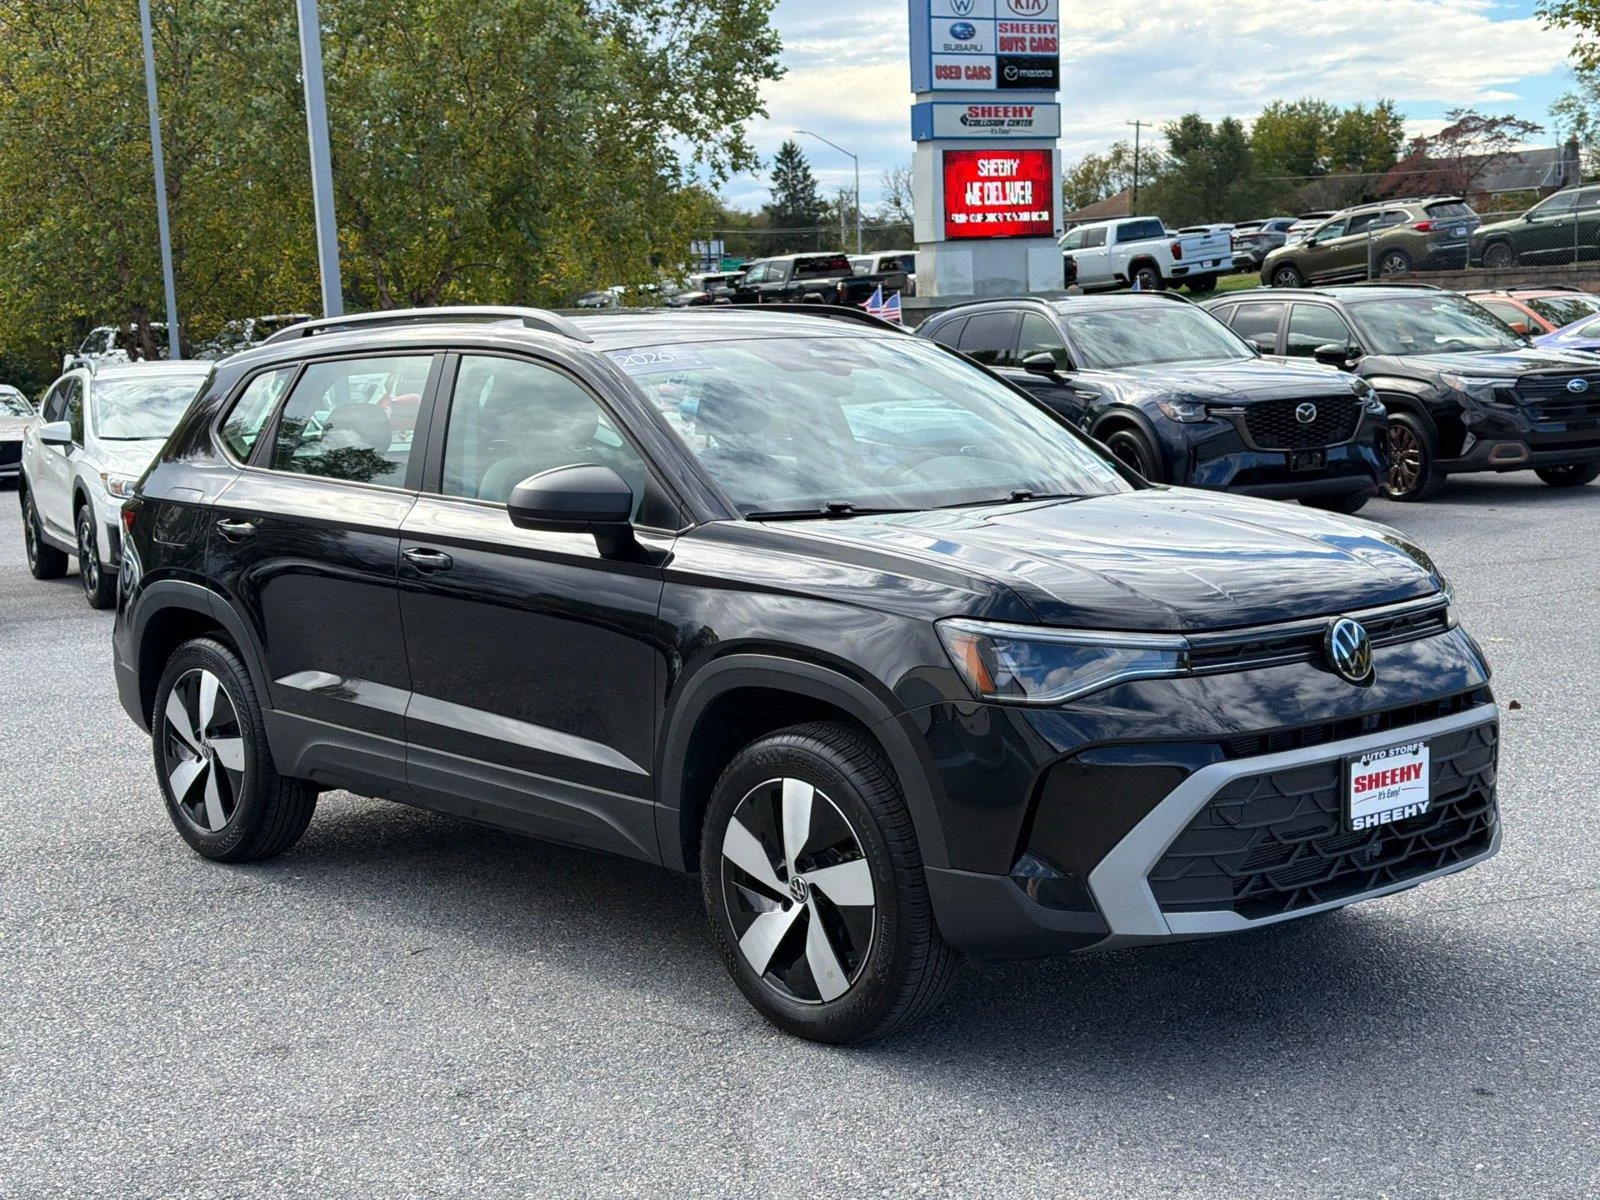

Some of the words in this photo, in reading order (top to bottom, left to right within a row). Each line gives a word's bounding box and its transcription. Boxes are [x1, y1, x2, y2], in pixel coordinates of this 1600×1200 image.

[998, 22, 1056, 35] SHEEHY
[943, 43, 982, 52] SUBARU
[1000, 36, 1027, 52] BUYS
[1030, 36, 1057, 52] CARS
[935, 65, 962, 80] USED
[964, 65, 992, 80] CARS
[968, 106, 1034, 118] SHEEHY
[968, 119, 1005, 127] COLLISION
[1007, 119, 1034, 127] CENTER
[977, 158, 1020, 177] SHEEHY
[965, 181, 983, 206] WE
[984, 181, 1033, 206] DELIVER
[614, 352, 674, 367] 2026
[1360, 751, 1386, 763] AUTO
[1354, 762, 1424, 794] SHEEHY
[1377, 790, 1386, 801] It's
[1386, 786, 1401, 800] Easy!
[1352, 801, 1430, 831] SHEEHY
